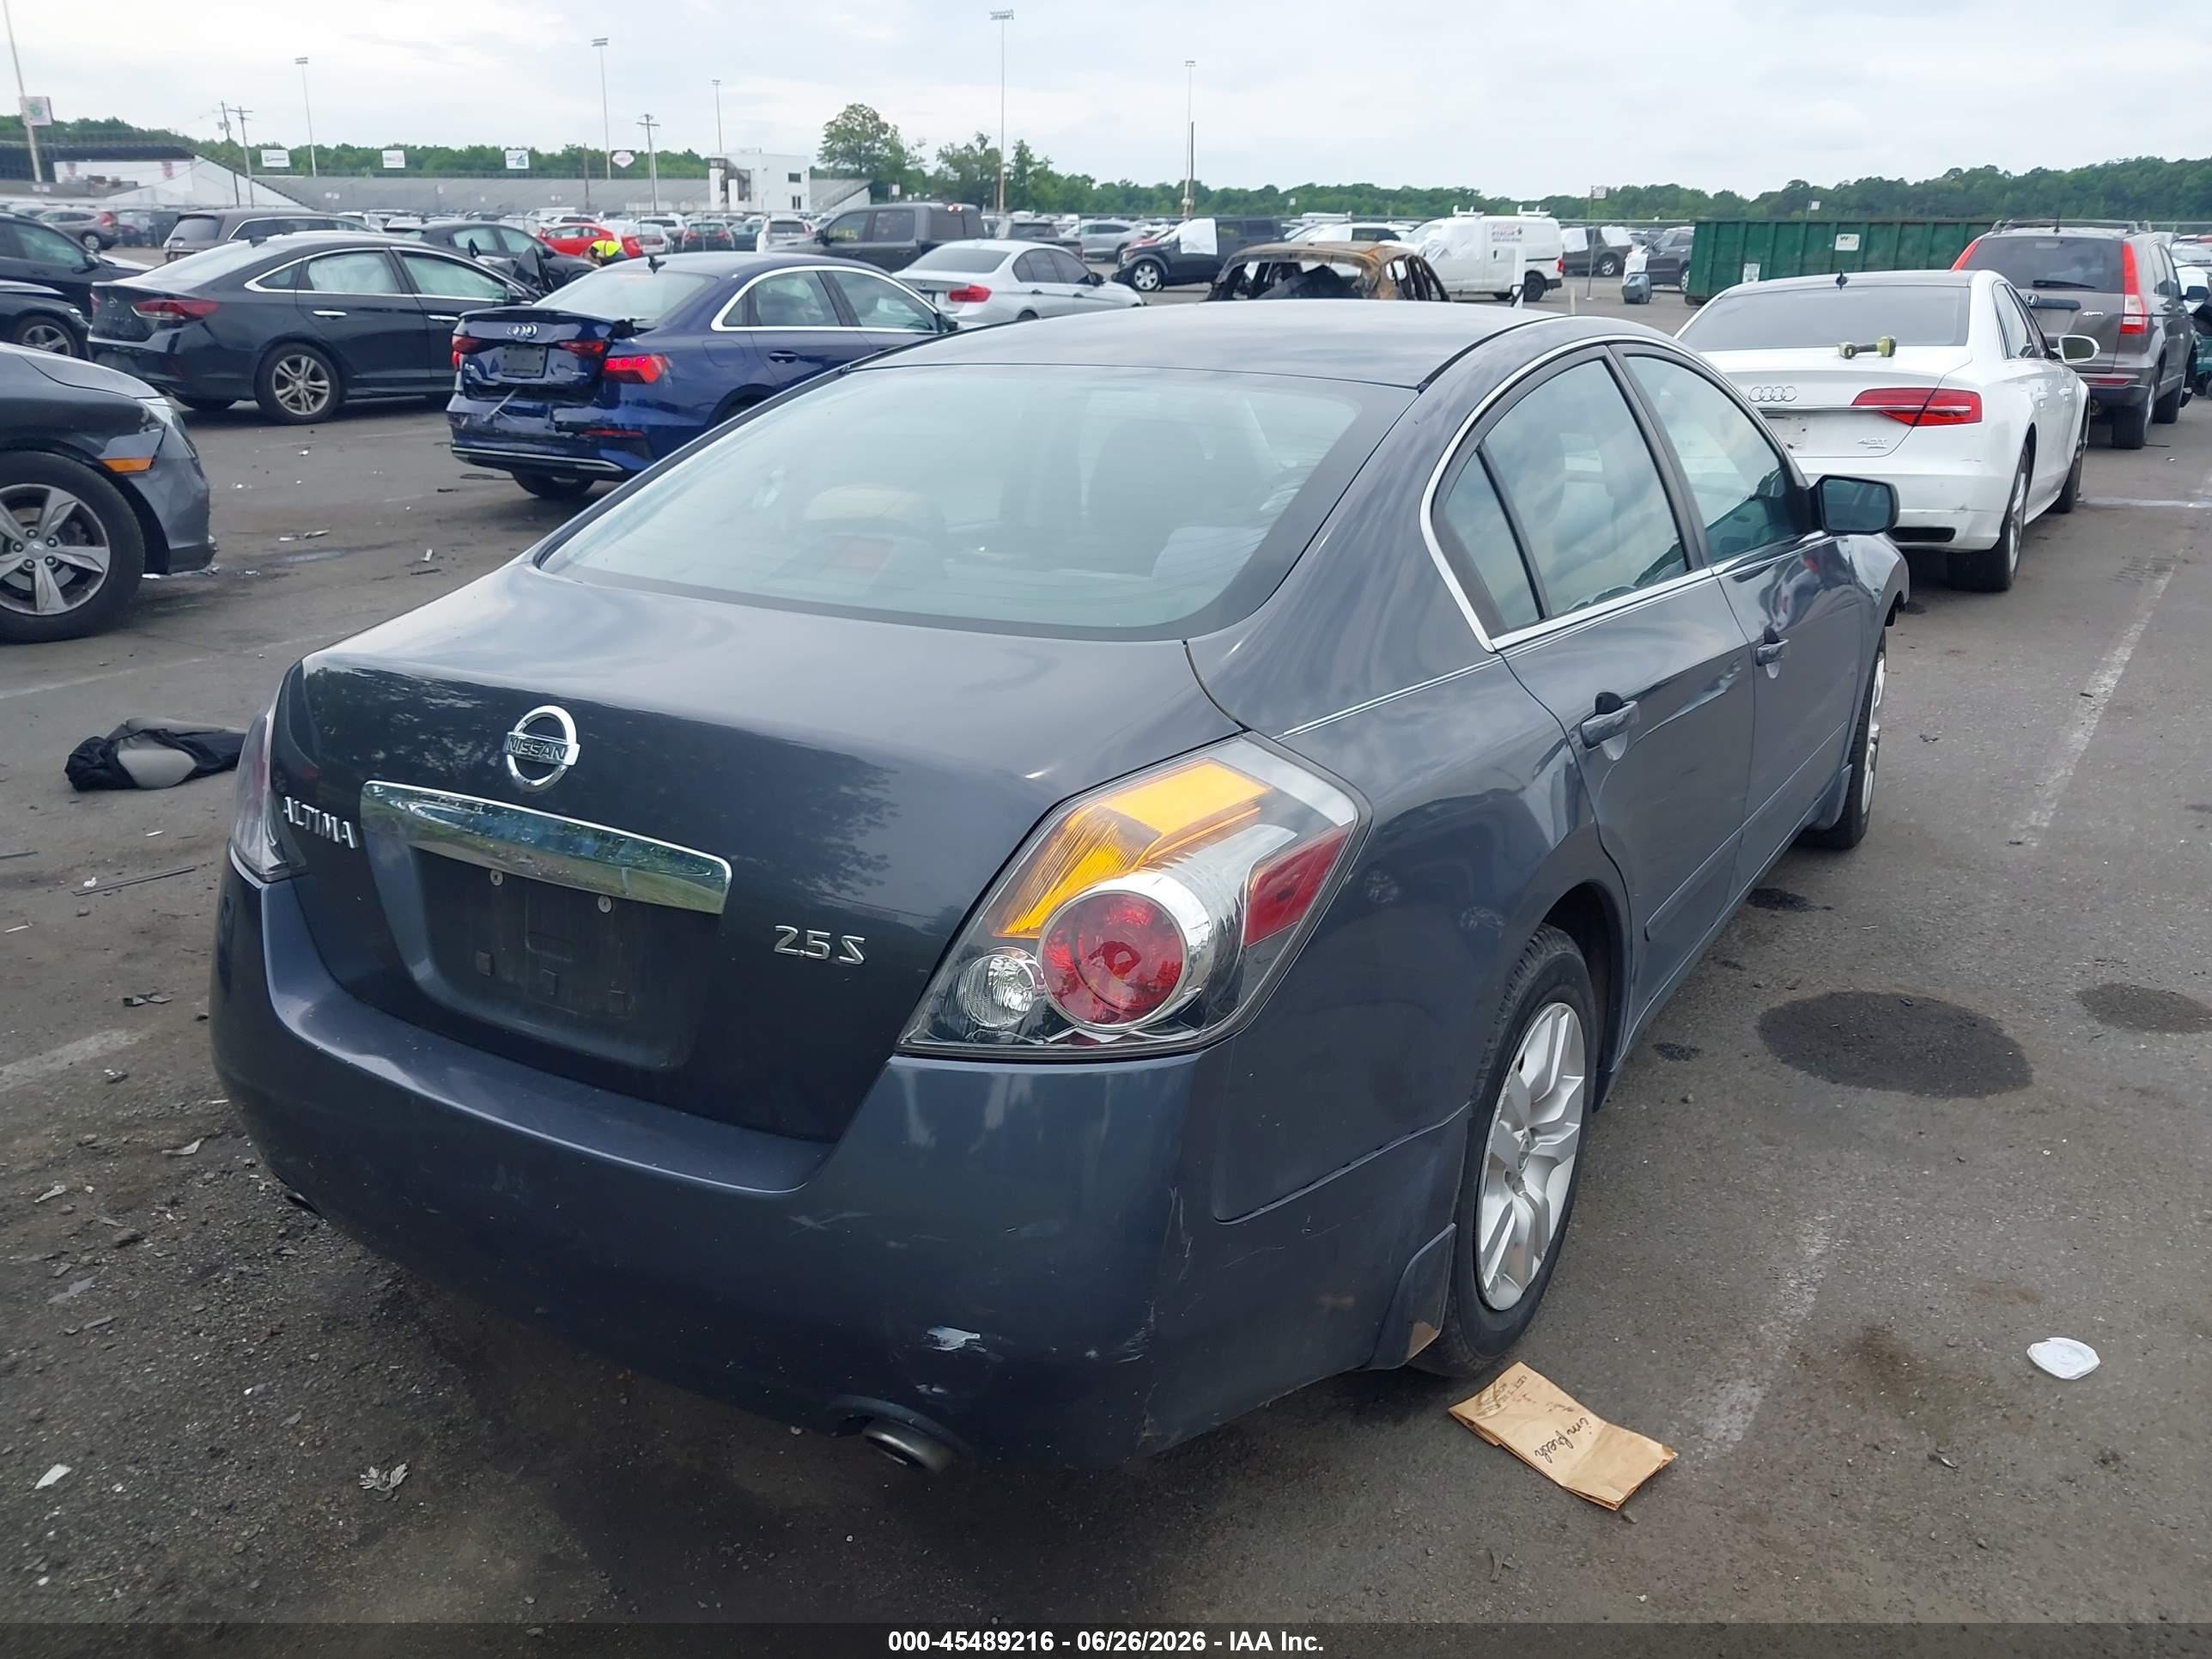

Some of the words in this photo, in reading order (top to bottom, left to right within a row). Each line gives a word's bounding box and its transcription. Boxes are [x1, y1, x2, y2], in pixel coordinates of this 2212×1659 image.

[507, 735, 567, 762] NISSAN
[283, 796, 358, 848] ALTIMA
[774, 925, 831, 960] 2.5
[838, 935, 866, 965] S
[1534, 1430, 1574, 1464] fresh
